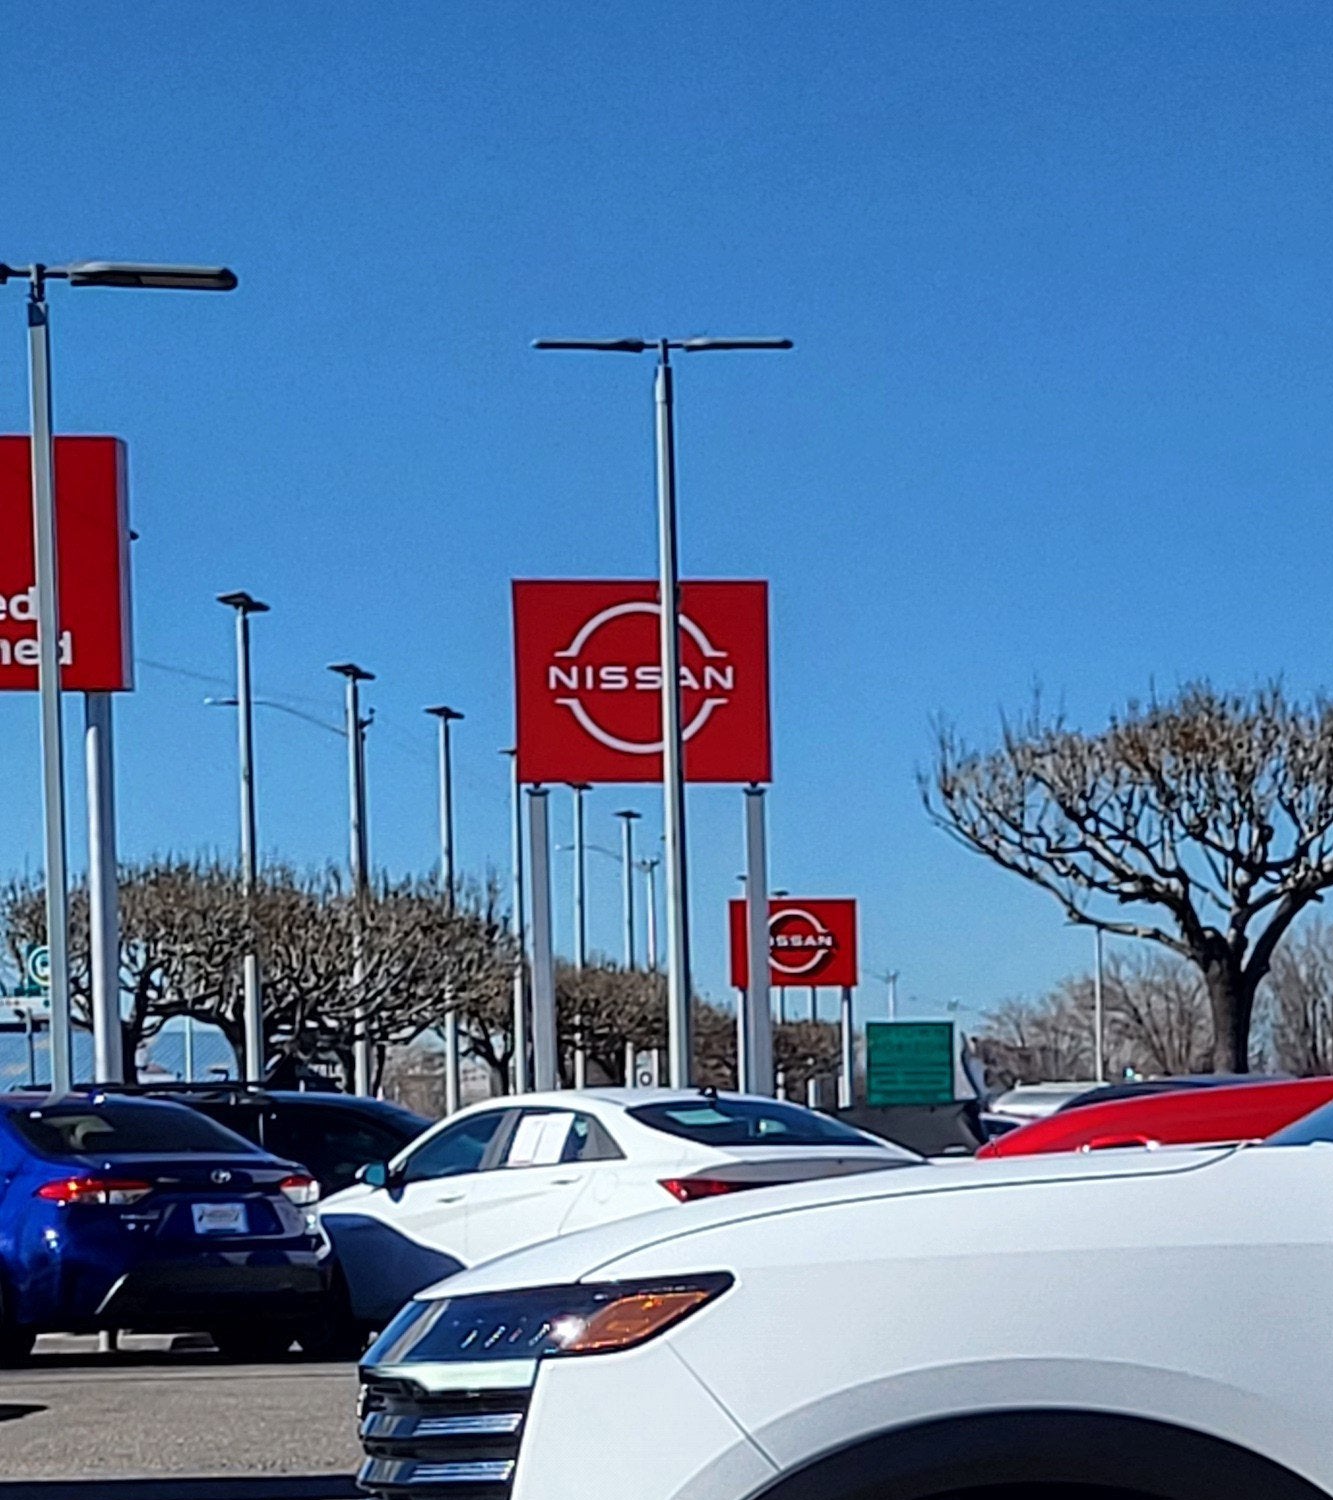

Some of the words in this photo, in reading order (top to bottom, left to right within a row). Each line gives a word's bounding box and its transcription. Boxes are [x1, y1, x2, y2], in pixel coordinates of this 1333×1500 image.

[0, 586, 40, 621] d
[548, 665, 735, 690] NISSAN
[768, 934, 833, 947] ISSAN
